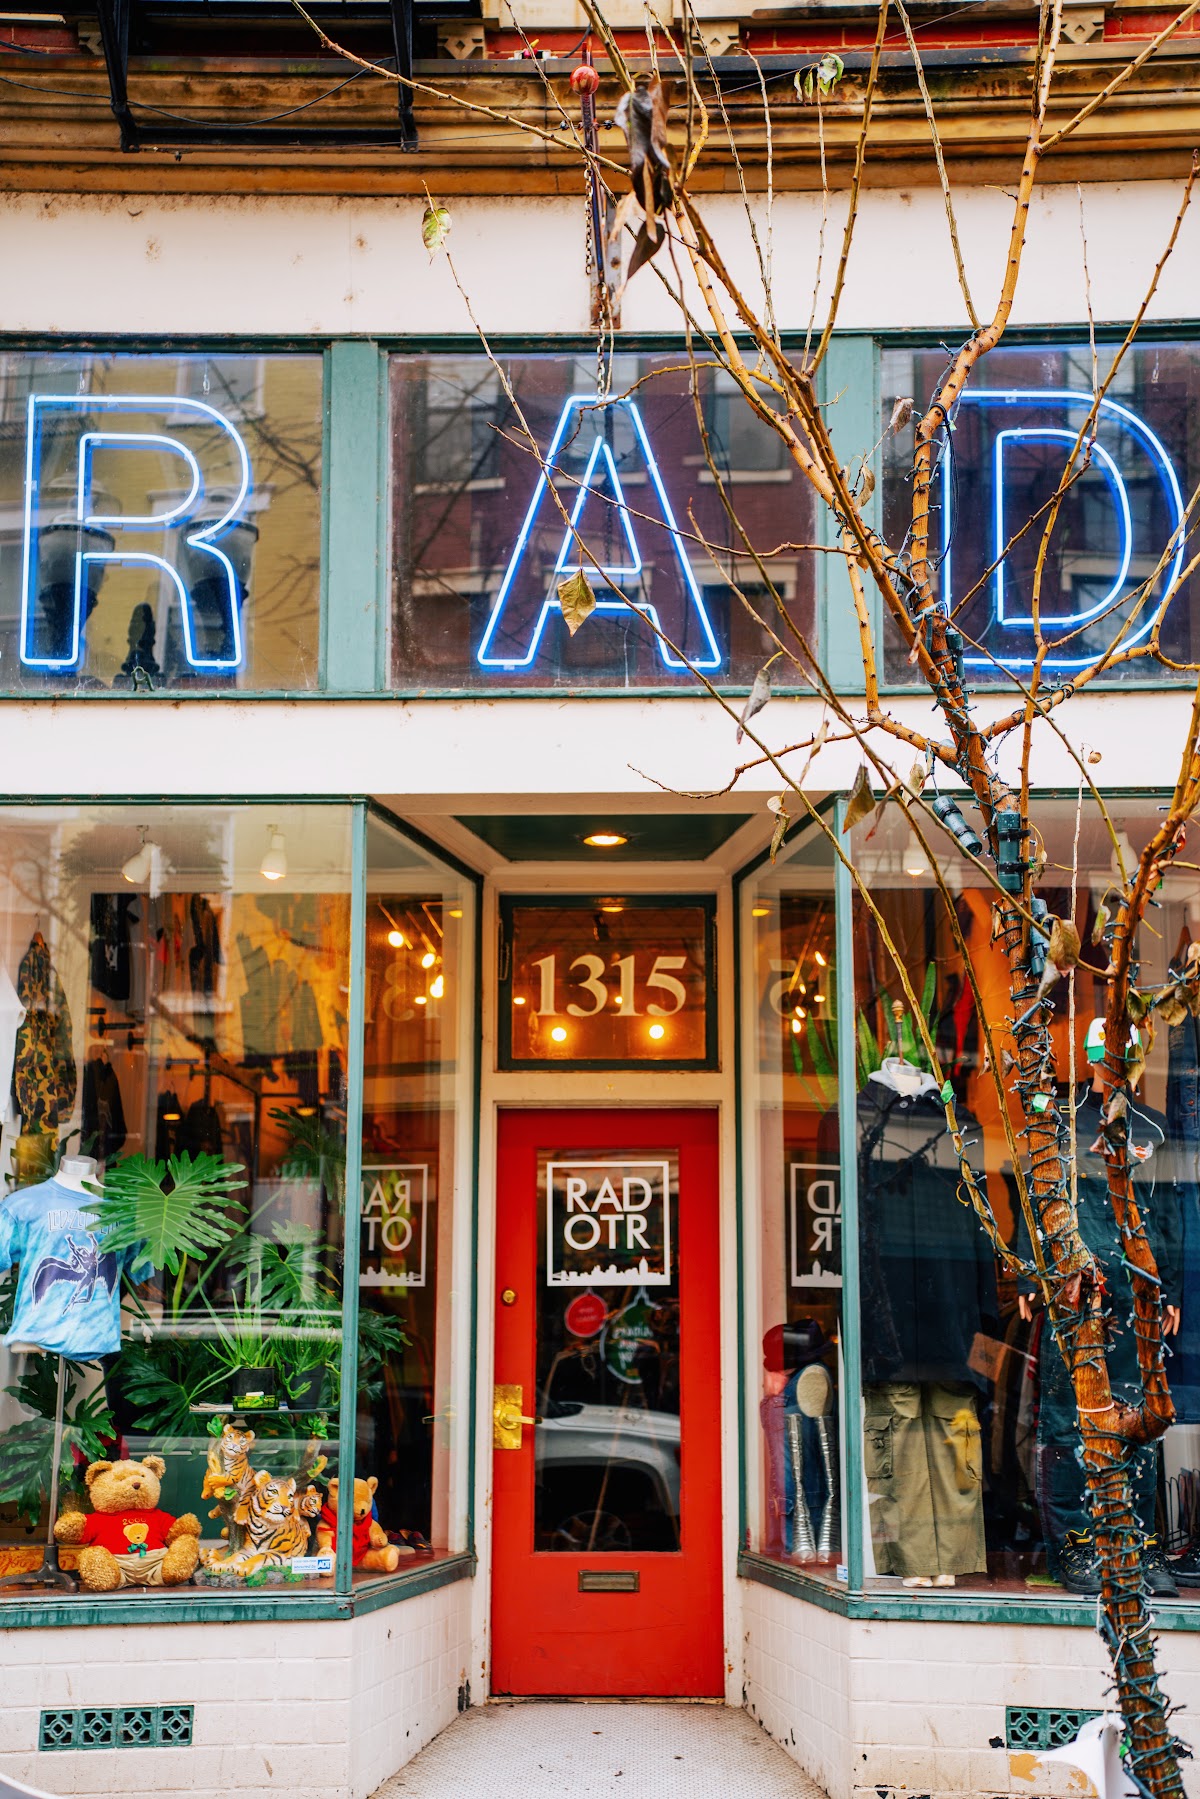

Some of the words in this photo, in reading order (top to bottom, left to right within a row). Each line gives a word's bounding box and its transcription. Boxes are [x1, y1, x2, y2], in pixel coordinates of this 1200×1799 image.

[20, 390, 1184, 670] RAD
[531, 954, 687, 1017] 1315
[566, 1176, 652, 1213] RAD
[564, 1213, 651, 1251] OTR
[318, 1559, 330, 1569] ADT
